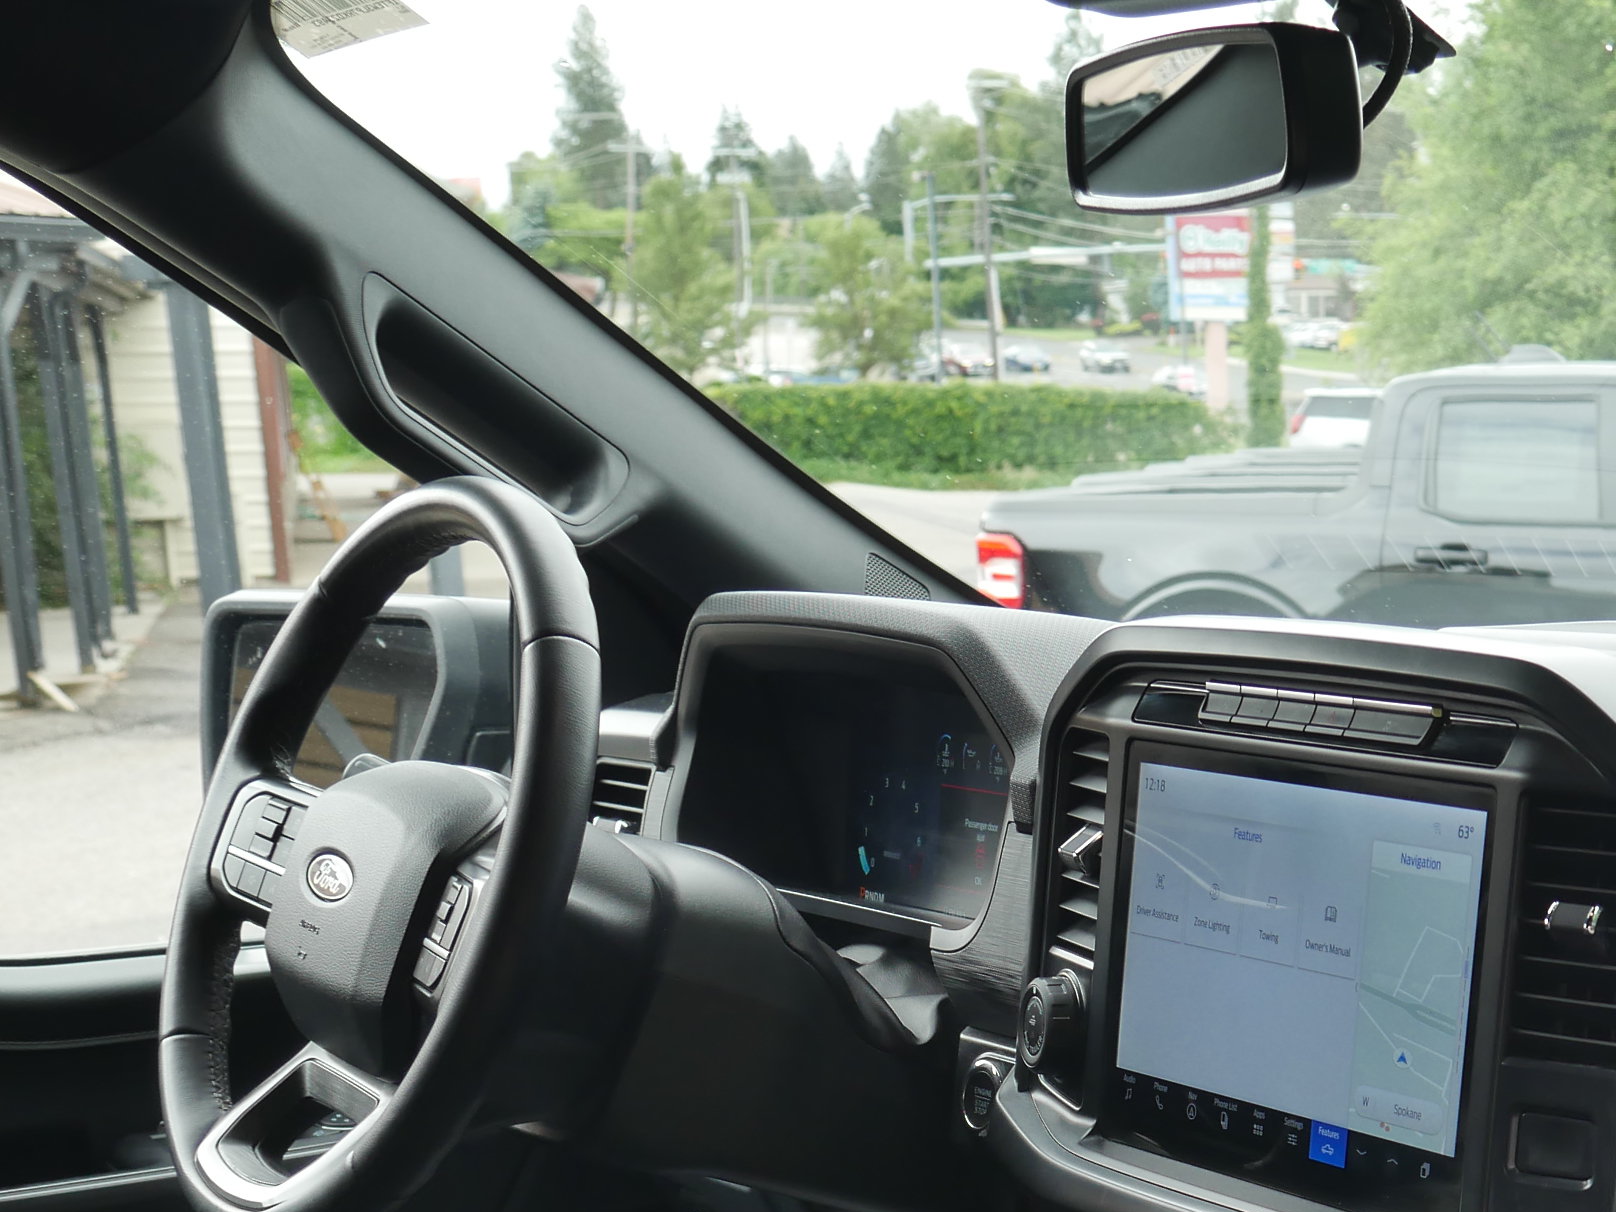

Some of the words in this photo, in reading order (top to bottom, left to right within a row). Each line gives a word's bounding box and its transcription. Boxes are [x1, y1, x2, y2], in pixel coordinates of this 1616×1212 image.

[1145, 777, 1165, 792] 12:18
[1234, 827, 1263, 843] Features
[1400, 852, 1441, 870] Navigation
[1136, 905, 1151, 917] Driver
[1152, 908, 1179, 923] Assistance
[1194, 916, 1208, 928] Zone
[1208, 920, 1230, 935] Lighting
[1259, 929, 1278, 945] Towing
[1305, 939, 1328, 953] Owner's
[1329, 943, 1351, 957] Manual
[1154, 1081, 1168, 1093] Phone
[1362, 1096, 1369, 1107] W
[1393, 1104, 1422, 1120] Spokane
[1318, 1126, 1340, 1140] Features
